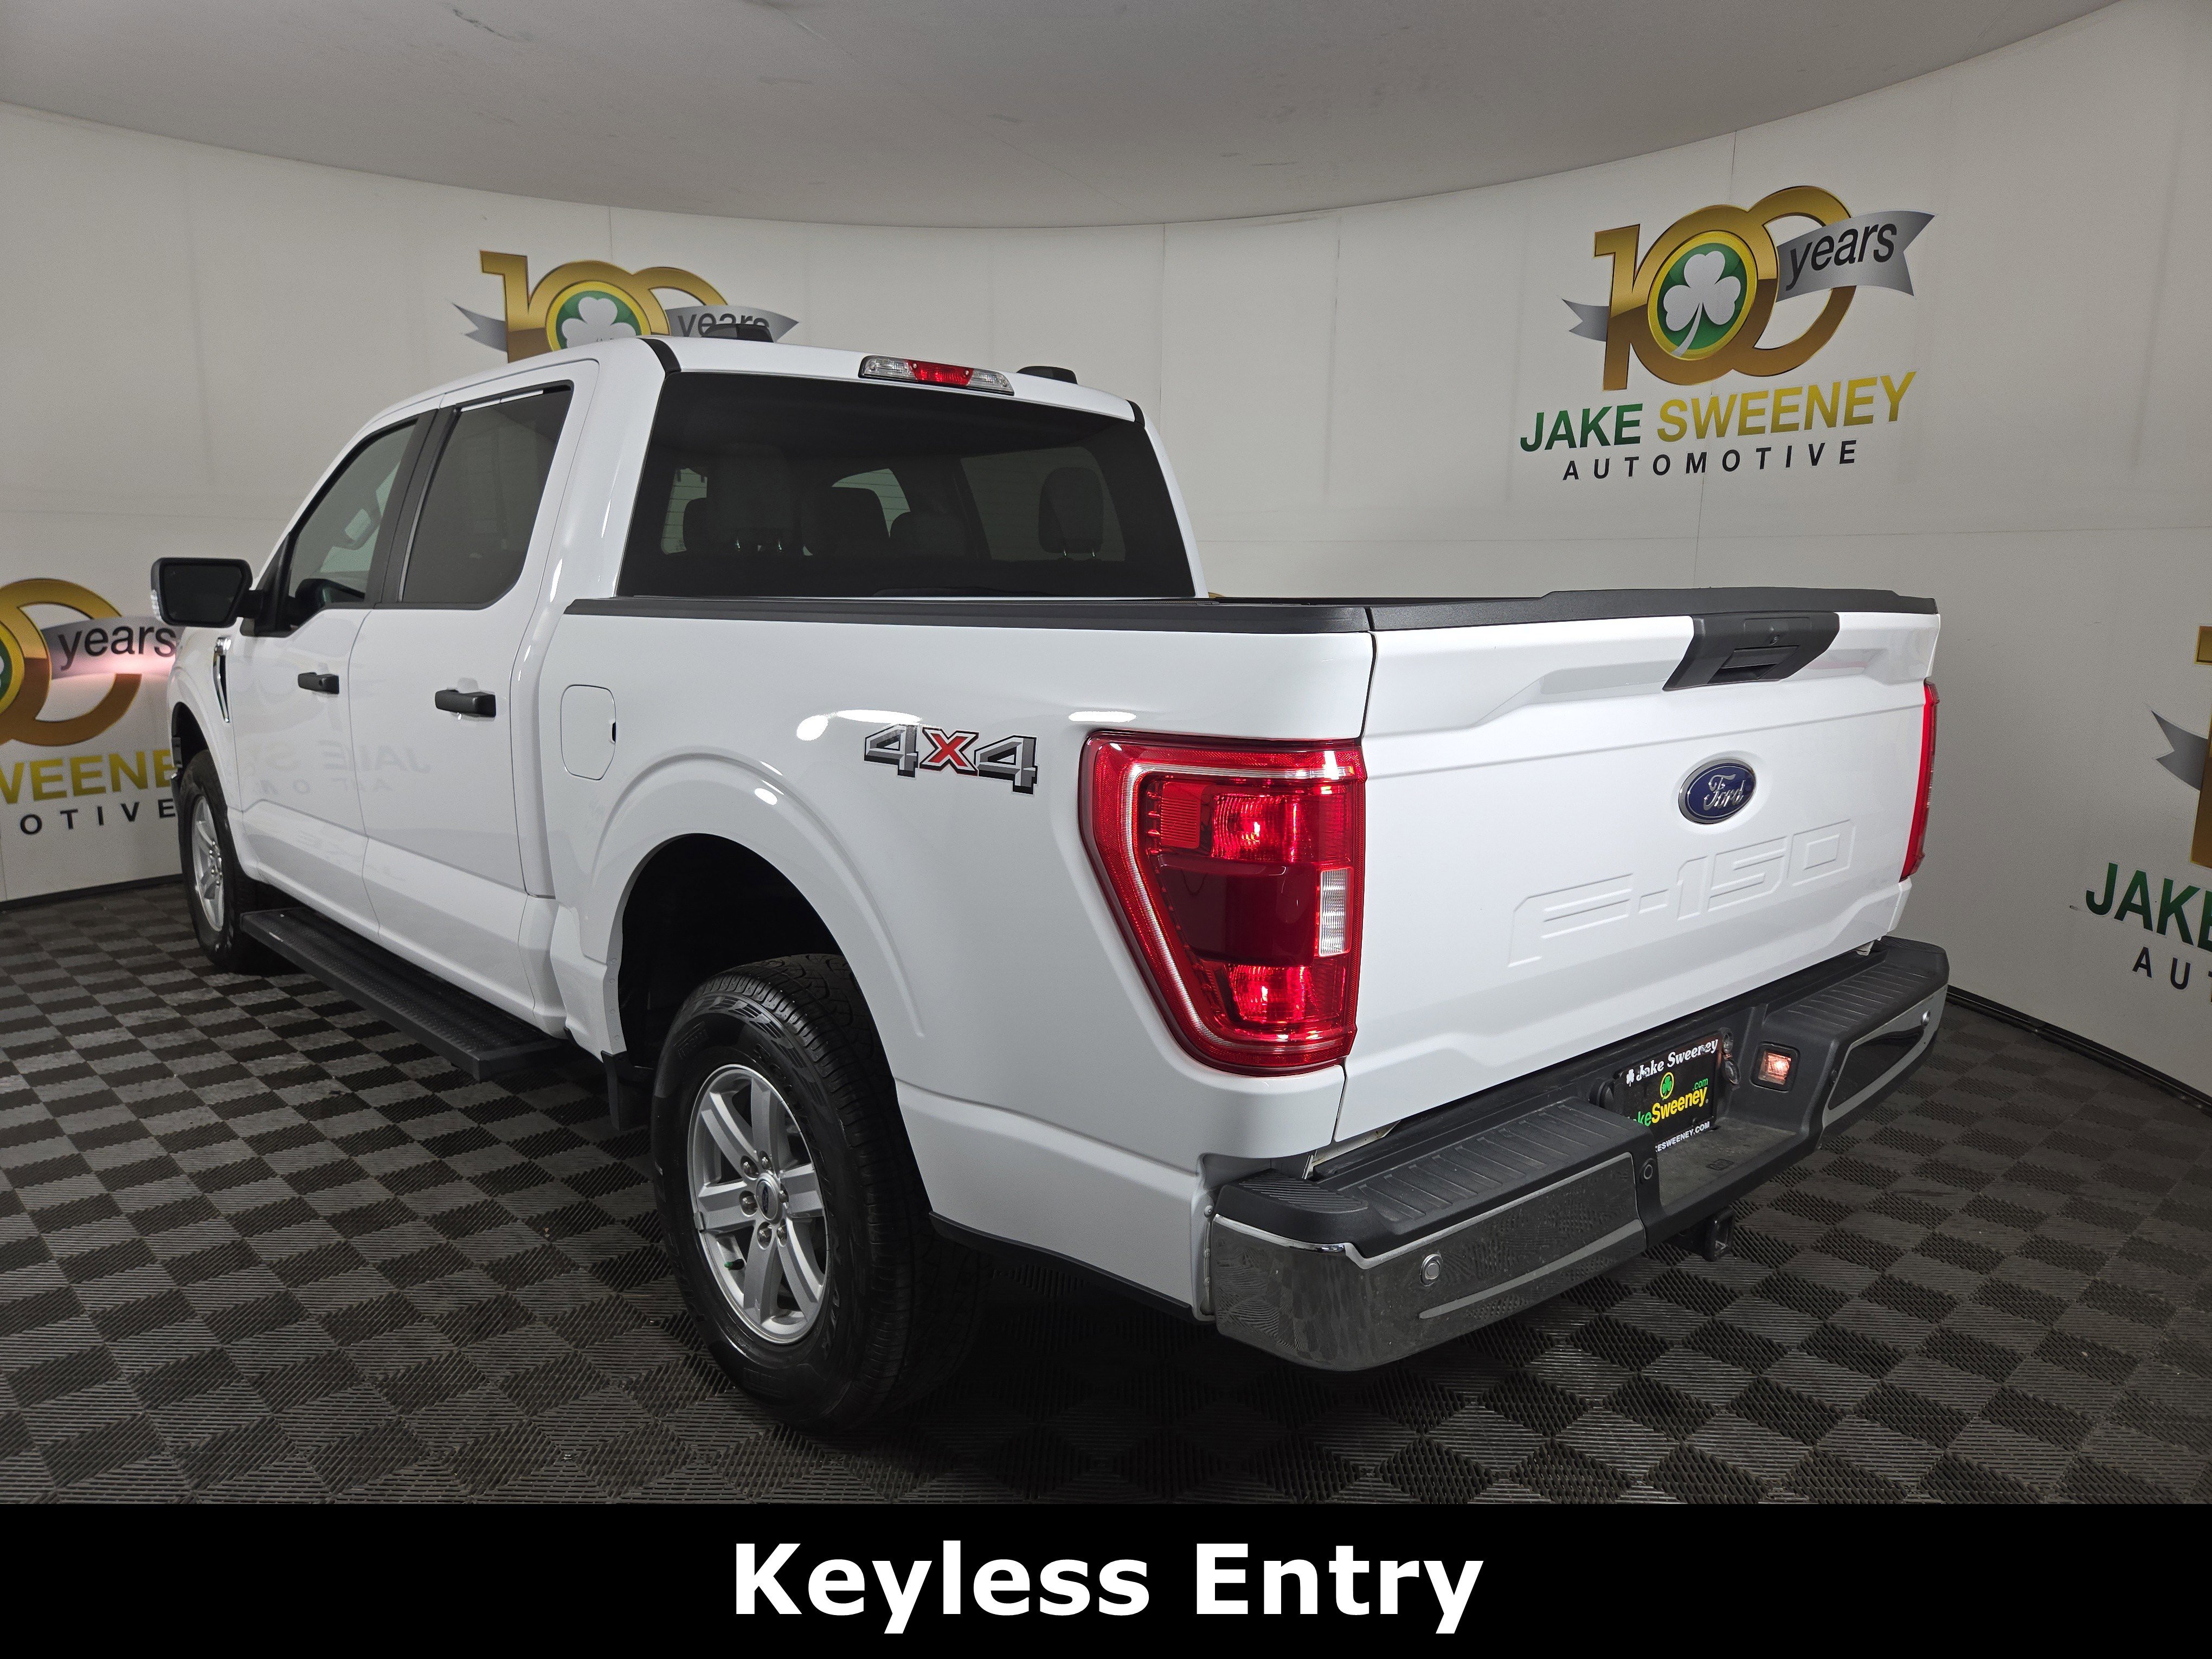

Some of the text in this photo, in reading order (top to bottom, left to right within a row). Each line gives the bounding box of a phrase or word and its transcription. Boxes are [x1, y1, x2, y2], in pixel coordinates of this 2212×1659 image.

[1785, 221, 1898, 291] years
[1520, 371, 1917, 452] JAKE SWEENEY
[1562, 440, 1857, 481] AUTOMOTIVE
[58, 625, 176, 670] years
[1703, 773, 1745, 812] Ford
[1508, 819, 1856, 968] F-150
[2132, 946, 2212, 990] AU
[1636, 1039, 1719, 1082] Jake Sweeney
[1692, 1078, 1708, 1091] .com
